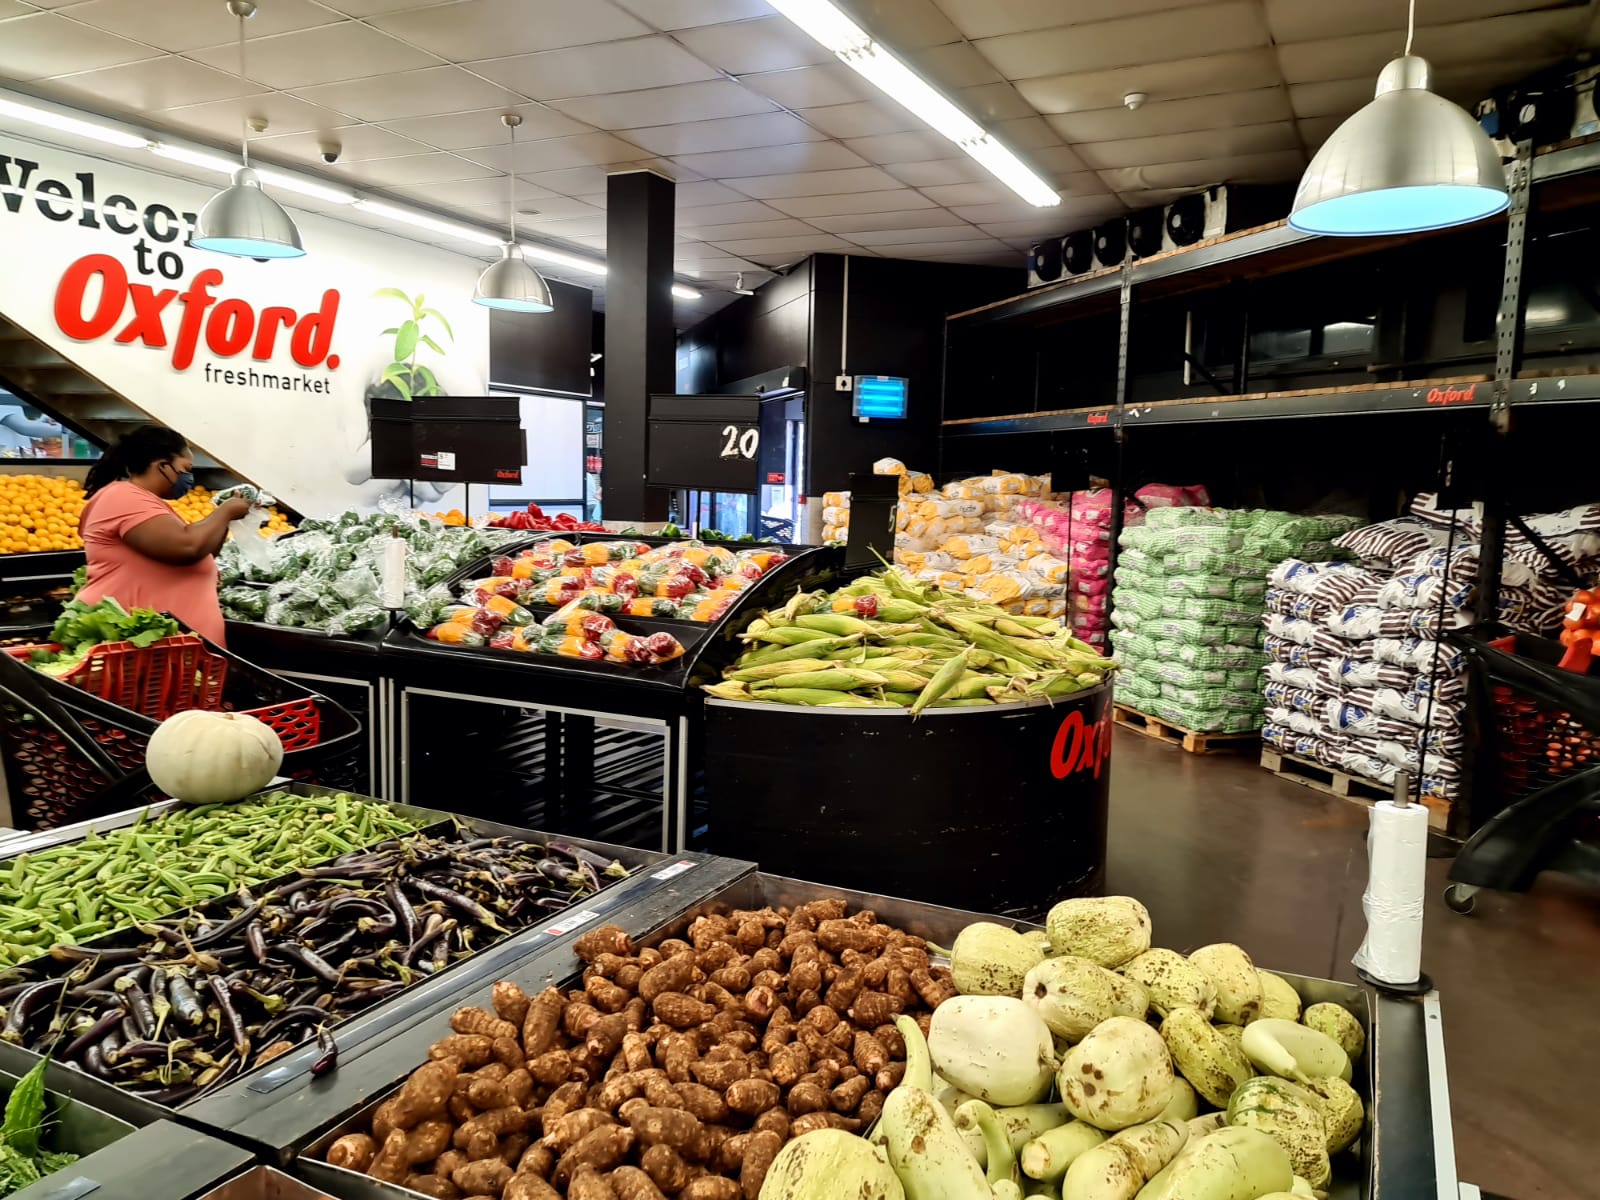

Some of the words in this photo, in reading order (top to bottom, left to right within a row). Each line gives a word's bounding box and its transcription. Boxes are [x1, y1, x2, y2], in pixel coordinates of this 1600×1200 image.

[0, 154, 270, 262] Welco
[133, 238, 184, 280] to
[54, 254, 340, 371] Oxford.
[205, 363, 331, 394] freshmarket
[720, 425, 759, 459] 20
